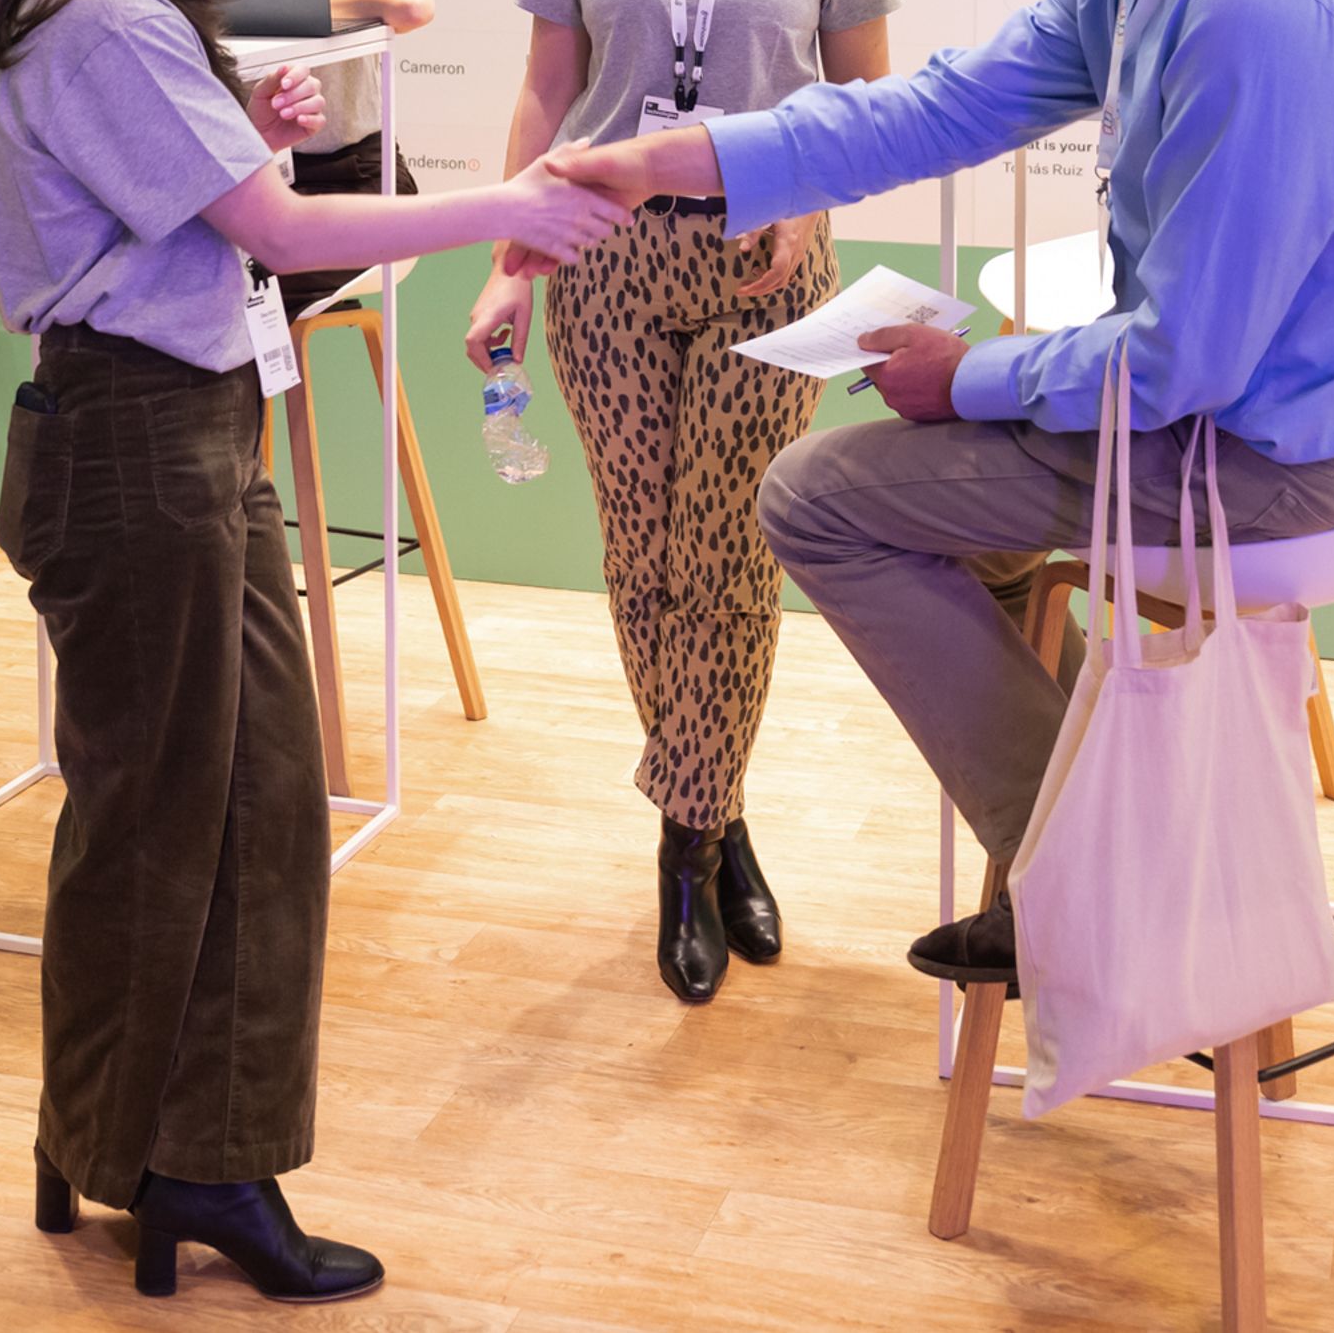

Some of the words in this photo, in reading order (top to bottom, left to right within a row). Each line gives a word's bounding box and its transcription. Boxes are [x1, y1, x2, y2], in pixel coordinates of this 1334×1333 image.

[400, 60, 465, 75] Cameron
[1044, 140, 1055, 151] is
[1059, 142, 1092, 153] your
[405, 156, 466, 170] nderson
[1052, 163, 1083, 176] Ruiz
